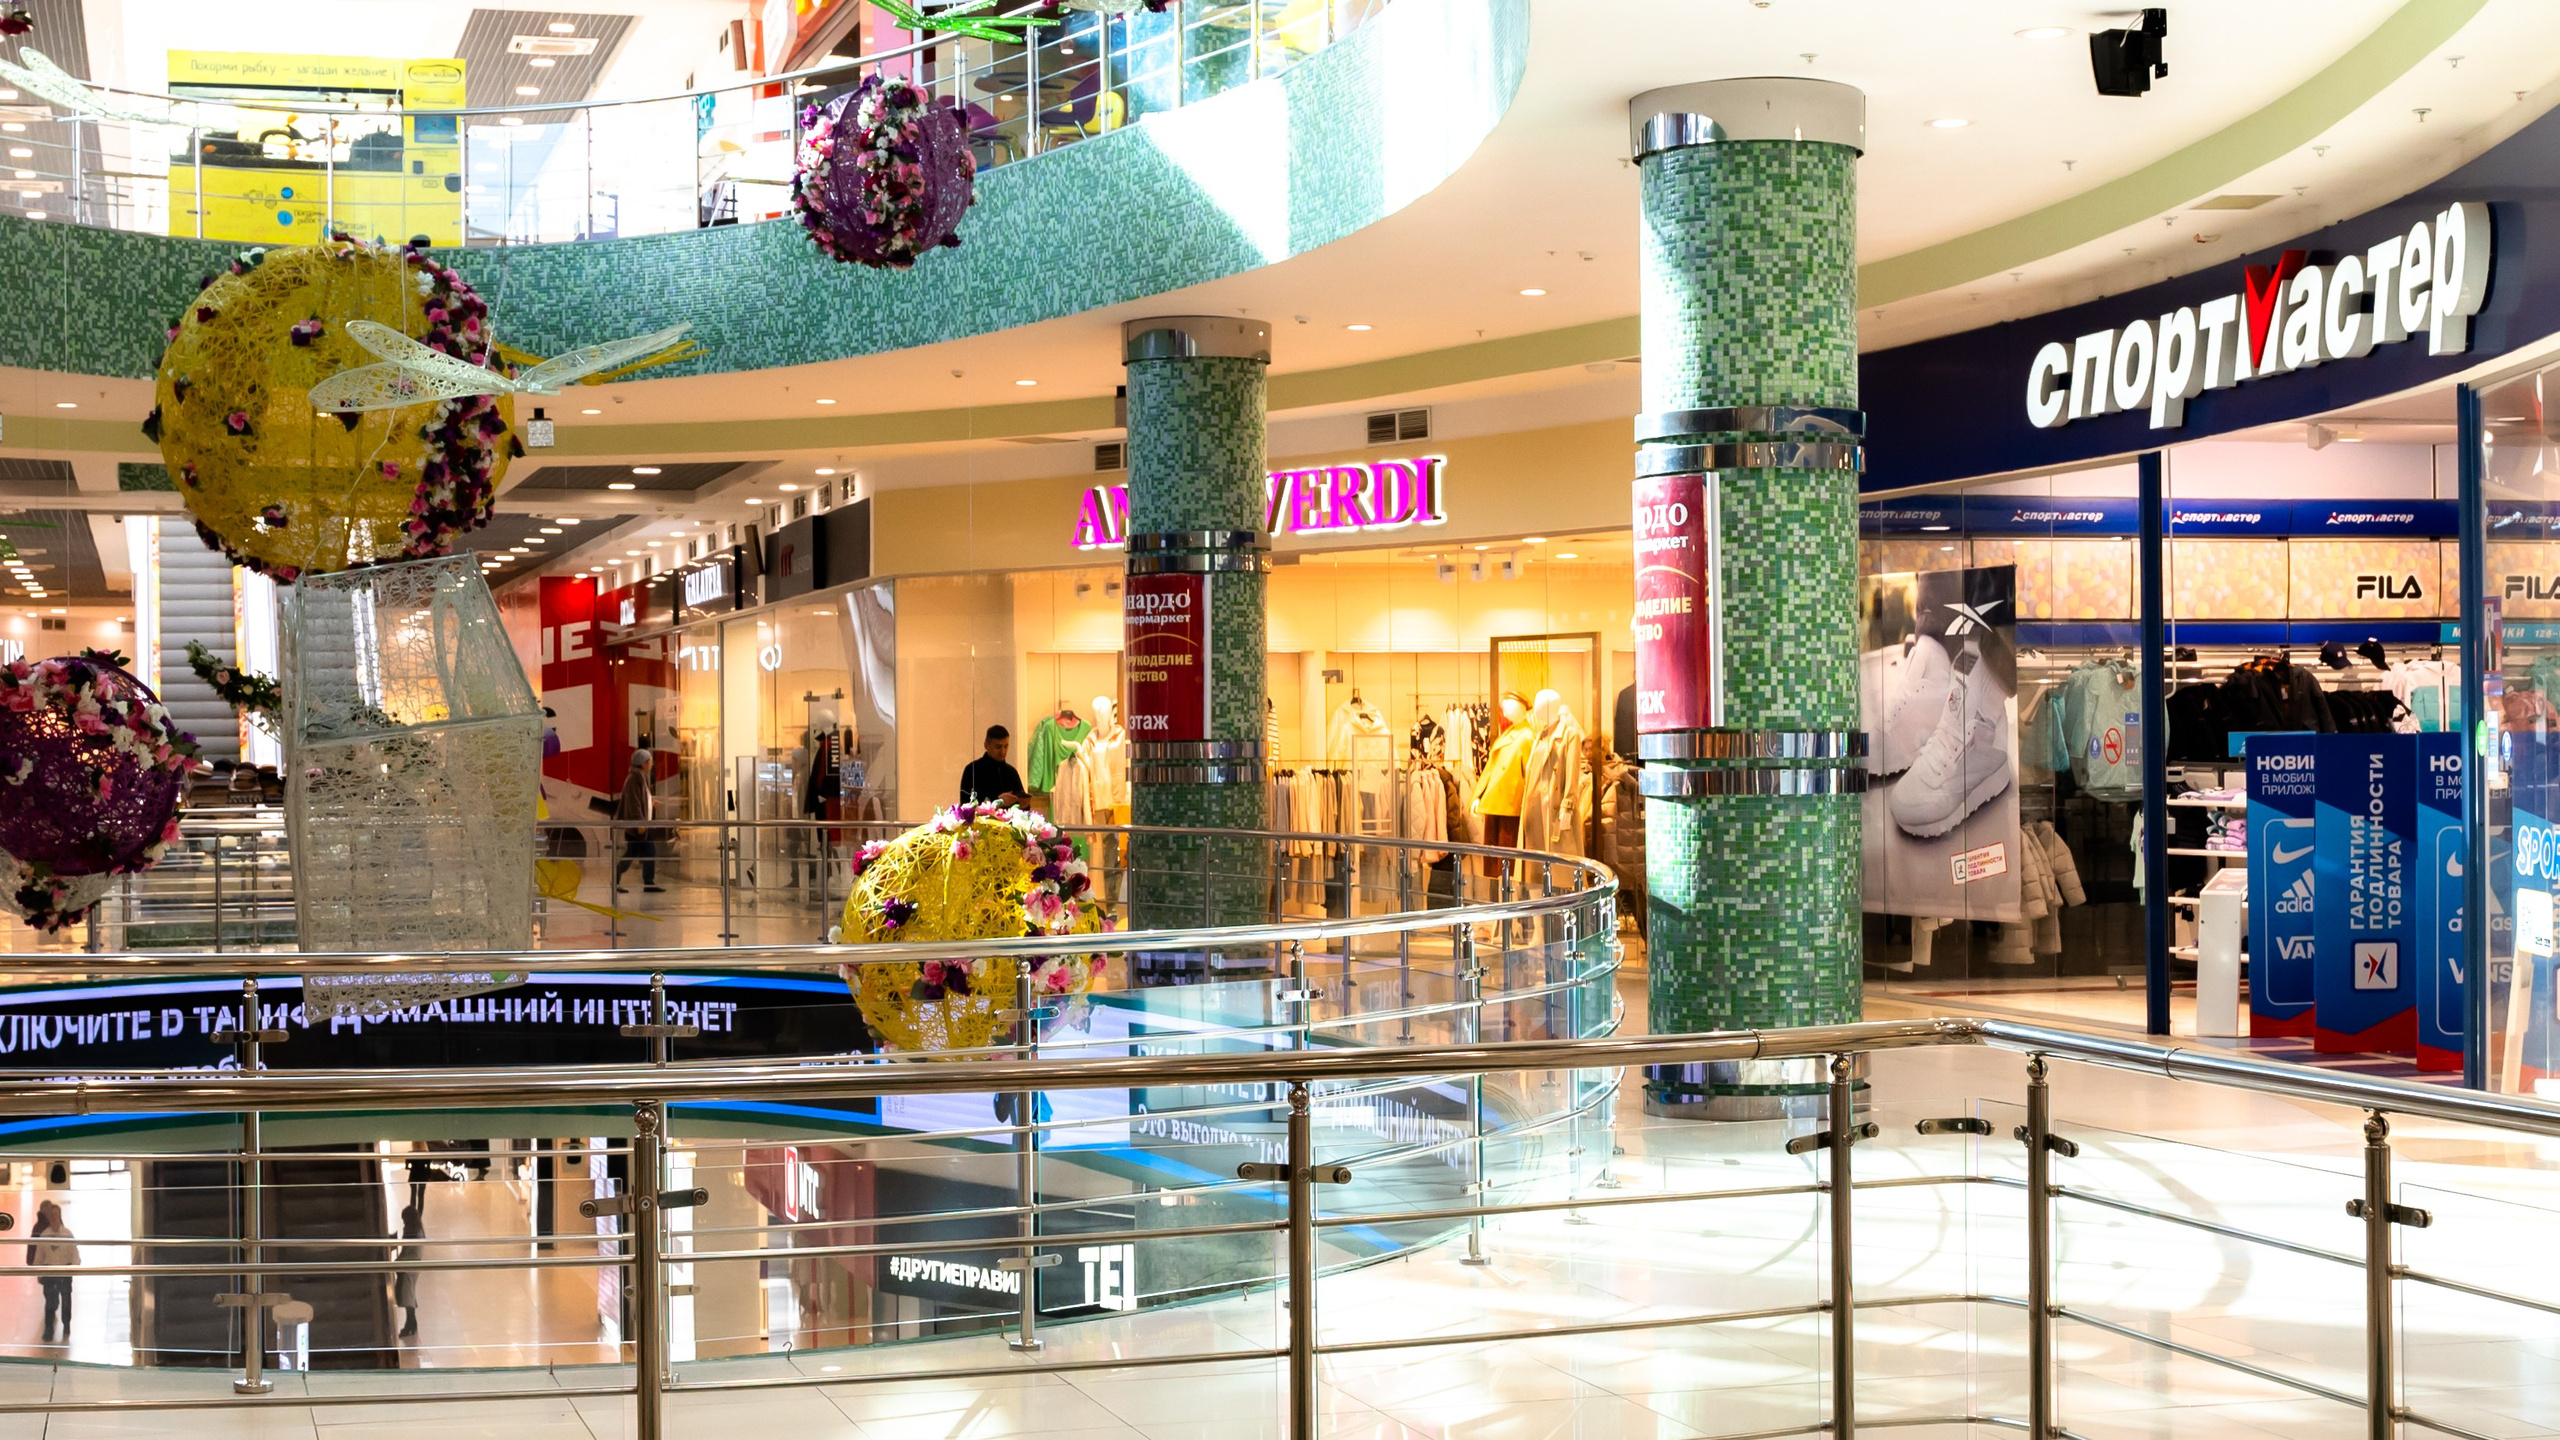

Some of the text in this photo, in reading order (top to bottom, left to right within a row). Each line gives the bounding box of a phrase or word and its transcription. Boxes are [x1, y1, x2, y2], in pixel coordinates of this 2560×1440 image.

[2026, 202, 2490, 429] спортмастер
[1635, 503, 1688, 538] рдо
[2022, 511, 2104, 524] спортмастер
[2181, 511, 2262, 525] спортмастер
[2337, 513, 2415, 525] спортмастер
[2357, 575, 2422, 599] FILA
[1125, 593, 1191, 614] нардо
[2262, 774, 2269, 783] В
[2435, 775, 2444, 786] В
[2369, 753, 2386, 930] ПОДЛИННОСТИ
[2350, 815, 2365, 930] ГАРАНТИЯ
[2388, 839, 2402, 930] ТОВАРА
